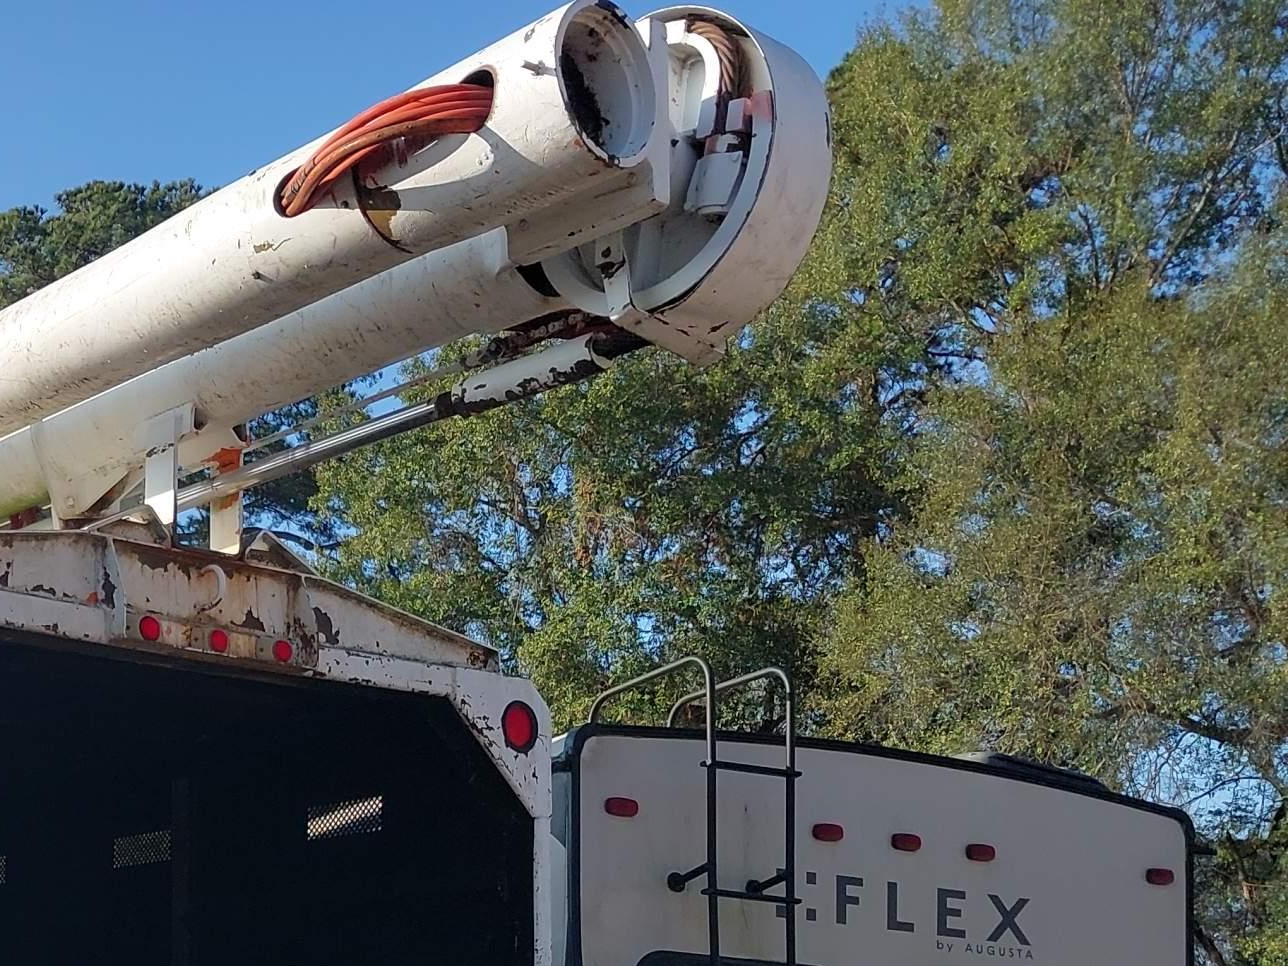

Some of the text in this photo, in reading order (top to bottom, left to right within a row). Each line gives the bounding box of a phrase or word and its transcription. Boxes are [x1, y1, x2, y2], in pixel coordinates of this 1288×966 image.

[836, 875, 1031, 946] FLEX
[936, 940, 1034, 960] by AUGUSTA
